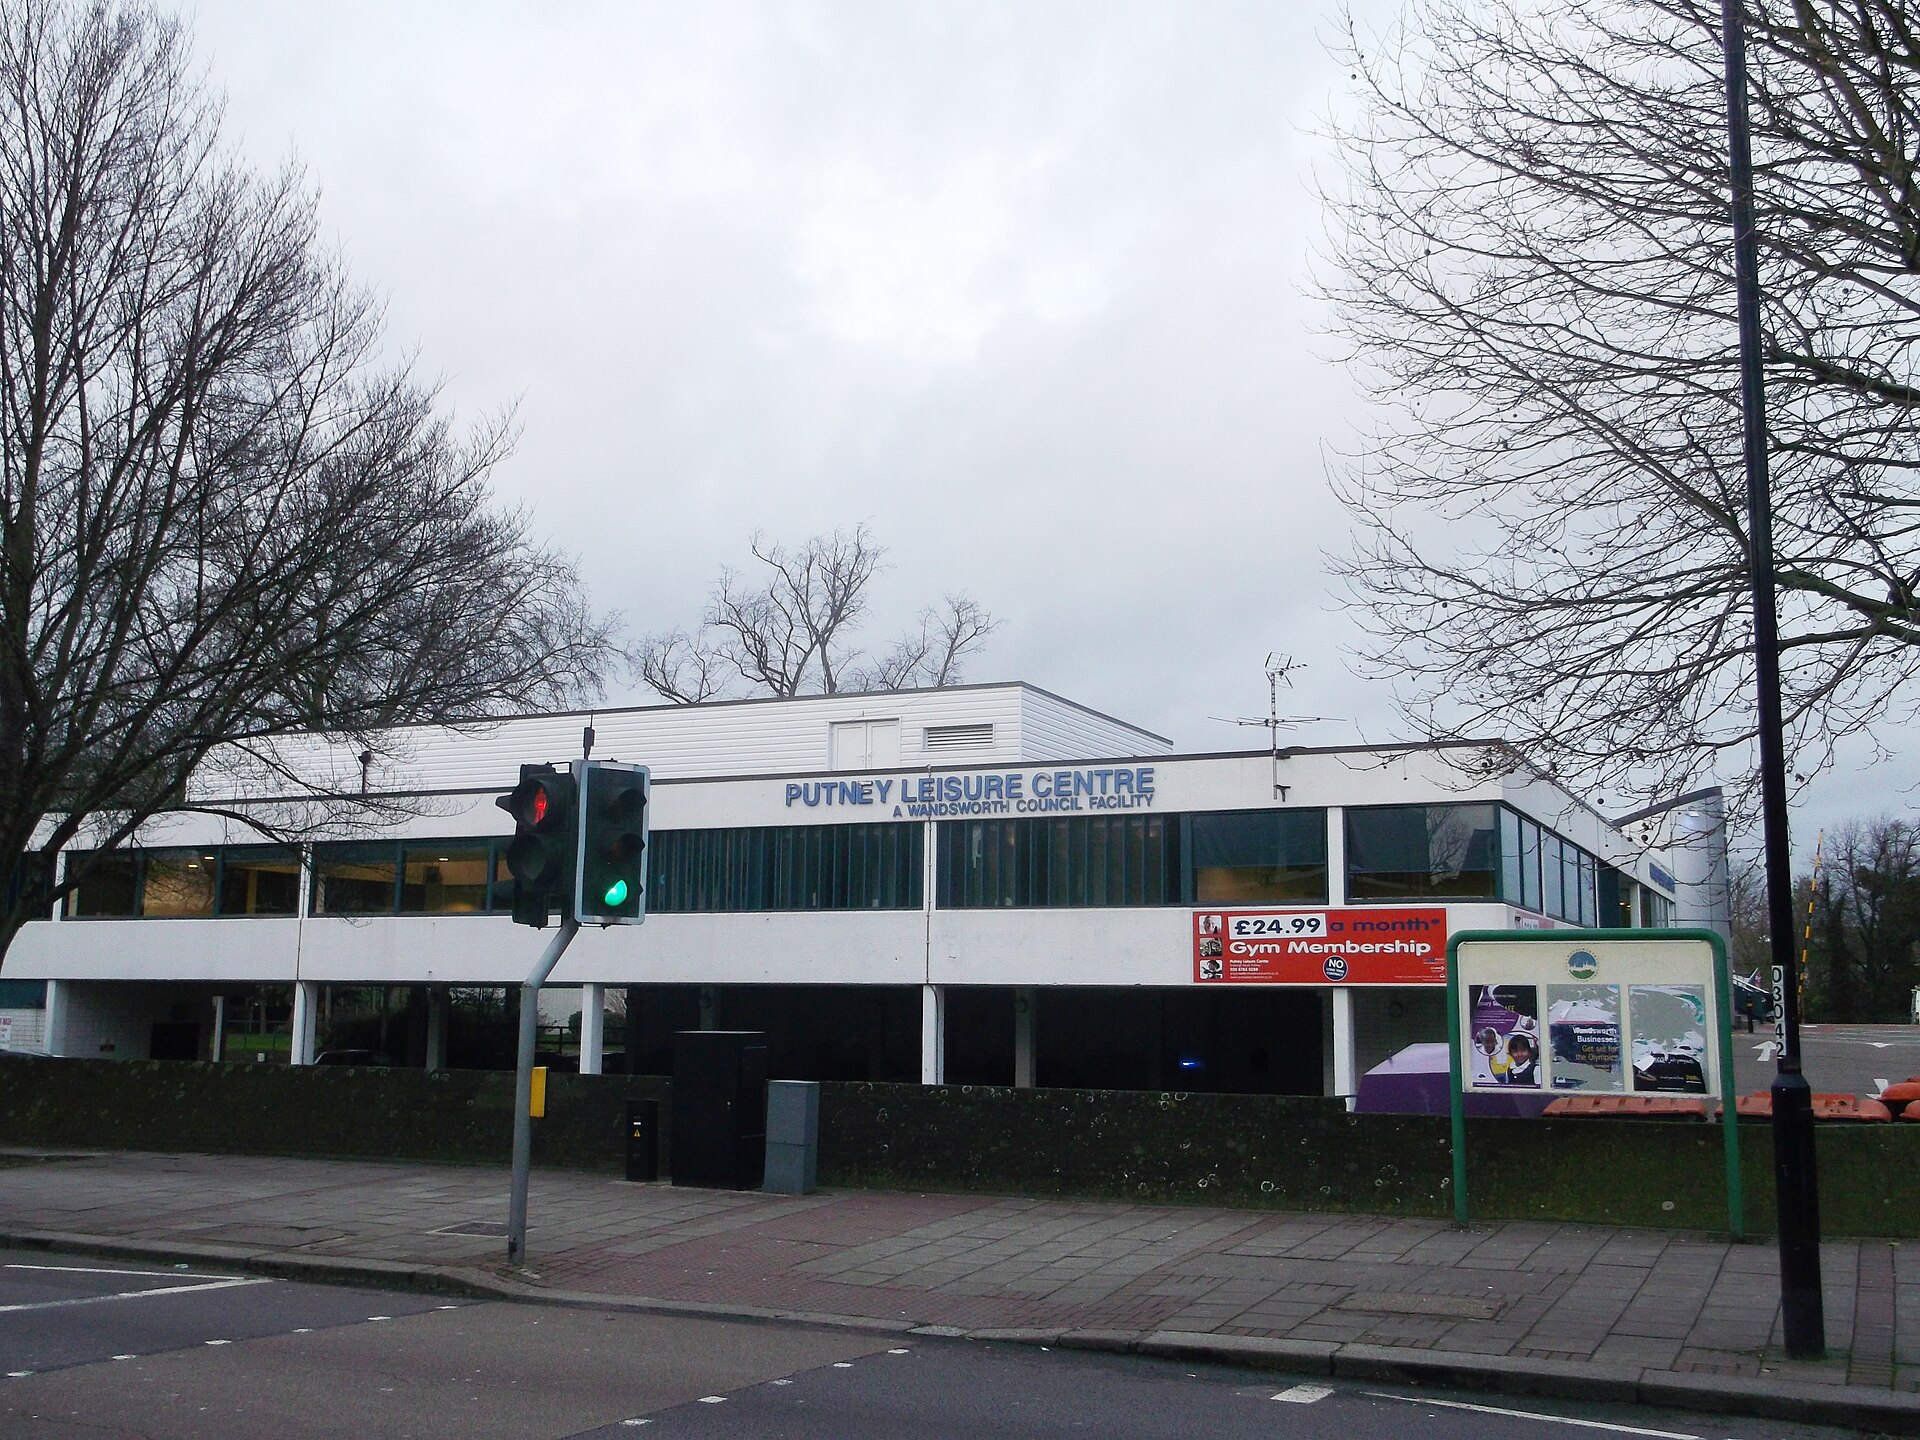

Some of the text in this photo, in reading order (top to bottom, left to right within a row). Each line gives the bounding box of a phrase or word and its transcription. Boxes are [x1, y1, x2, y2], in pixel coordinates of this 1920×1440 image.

[785, 767, 1155, 807] PUTNEY LEISURE CENTRE
[892, 793, 1155, 818] A WANDSWORTH COUNCIL FACILITY
[1234, 917, 1321, 936] £24.99
[1329, 921, 1345, 932] a
[1229, 939, 1431, 957] Gym Membership
[1328, 958, 1344, 969] NO
[1572, 1026, 1617, 1035] Wandsworth
[1577, 1035, 1618, 1043] Businesses
